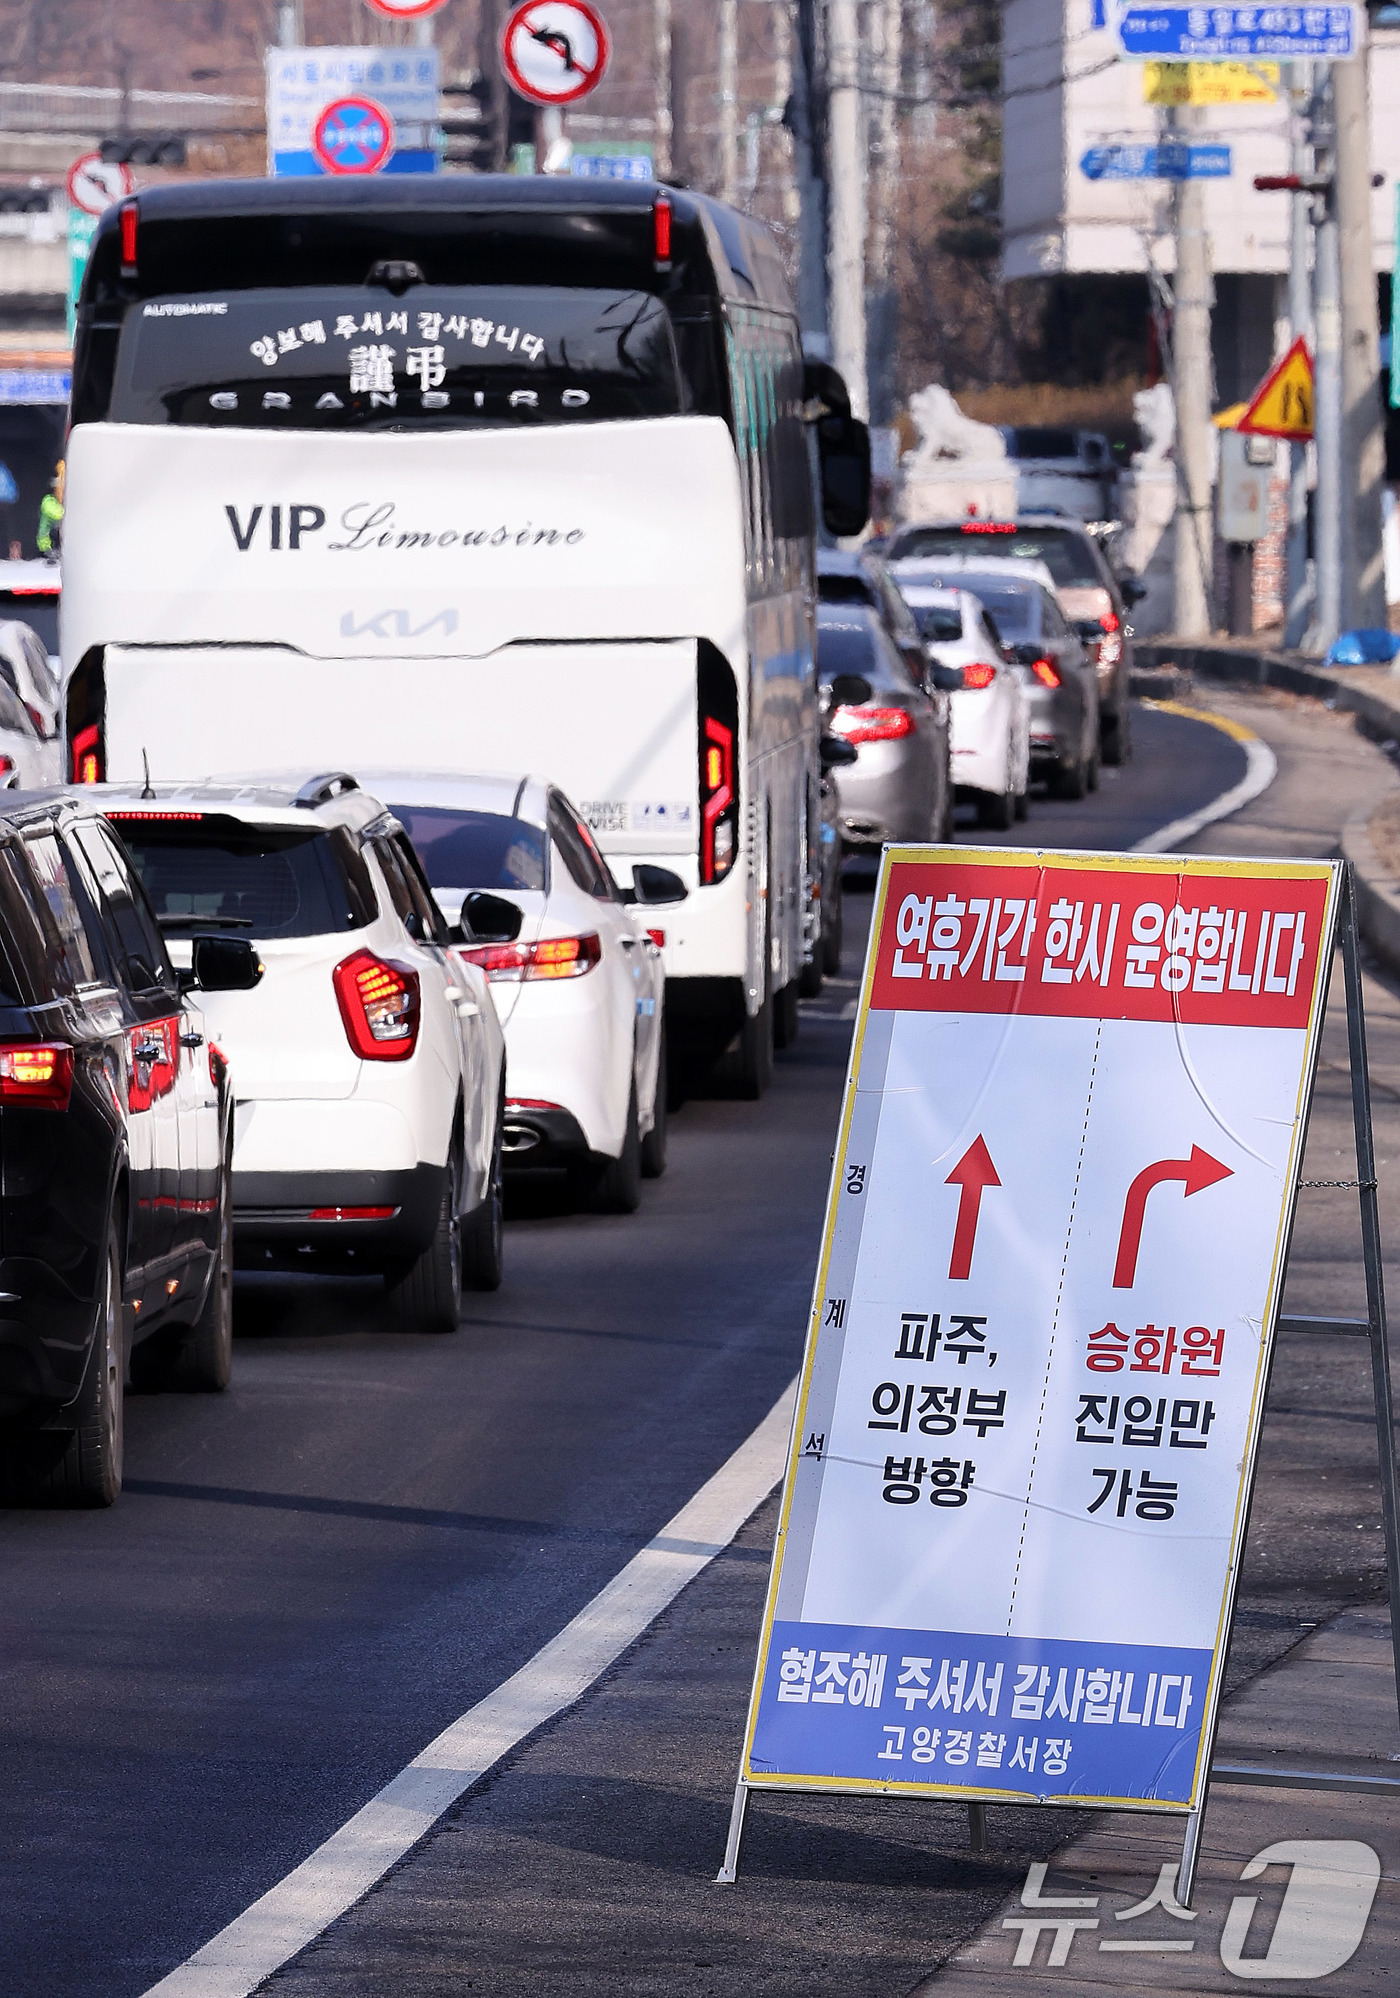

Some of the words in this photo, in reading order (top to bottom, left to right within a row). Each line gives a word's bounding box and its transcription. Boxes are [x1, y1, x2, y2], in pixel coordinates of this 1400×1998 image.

[143, 302, 228, 317] AUTOMATIC
[417, 310, 545, 362] 감사합니다
[208, 390, 591, 410] GRANBIRD
[225, 504, 326, 551] VIP
[328, 501, 586, 551] Limousine
[892, 893, 1037, 981] 연휴기간
[1041, 898, 1121, 987] 한시
[1123, 902, 1306, 997] 운영합니다
[894, 1313, 998, 1368] 파주,
[1086, 1322, 1226, 1377] 승화원
[867, 1382, 1007, 1438] 의정부
[1074, 1394, 1216, 1450] 진입만
[882, 1456, 976, 1508] 방향
[1086, 1468, 1179, 1521] 가능
[777, 1647, 888, 1708] 협조해
[895, 1656, 1003, 1717] 주셔서
[1010, 1664, 1193, 1730] 감사합니다
[877, 1725, 1073, 1776] 고양경찰서장
